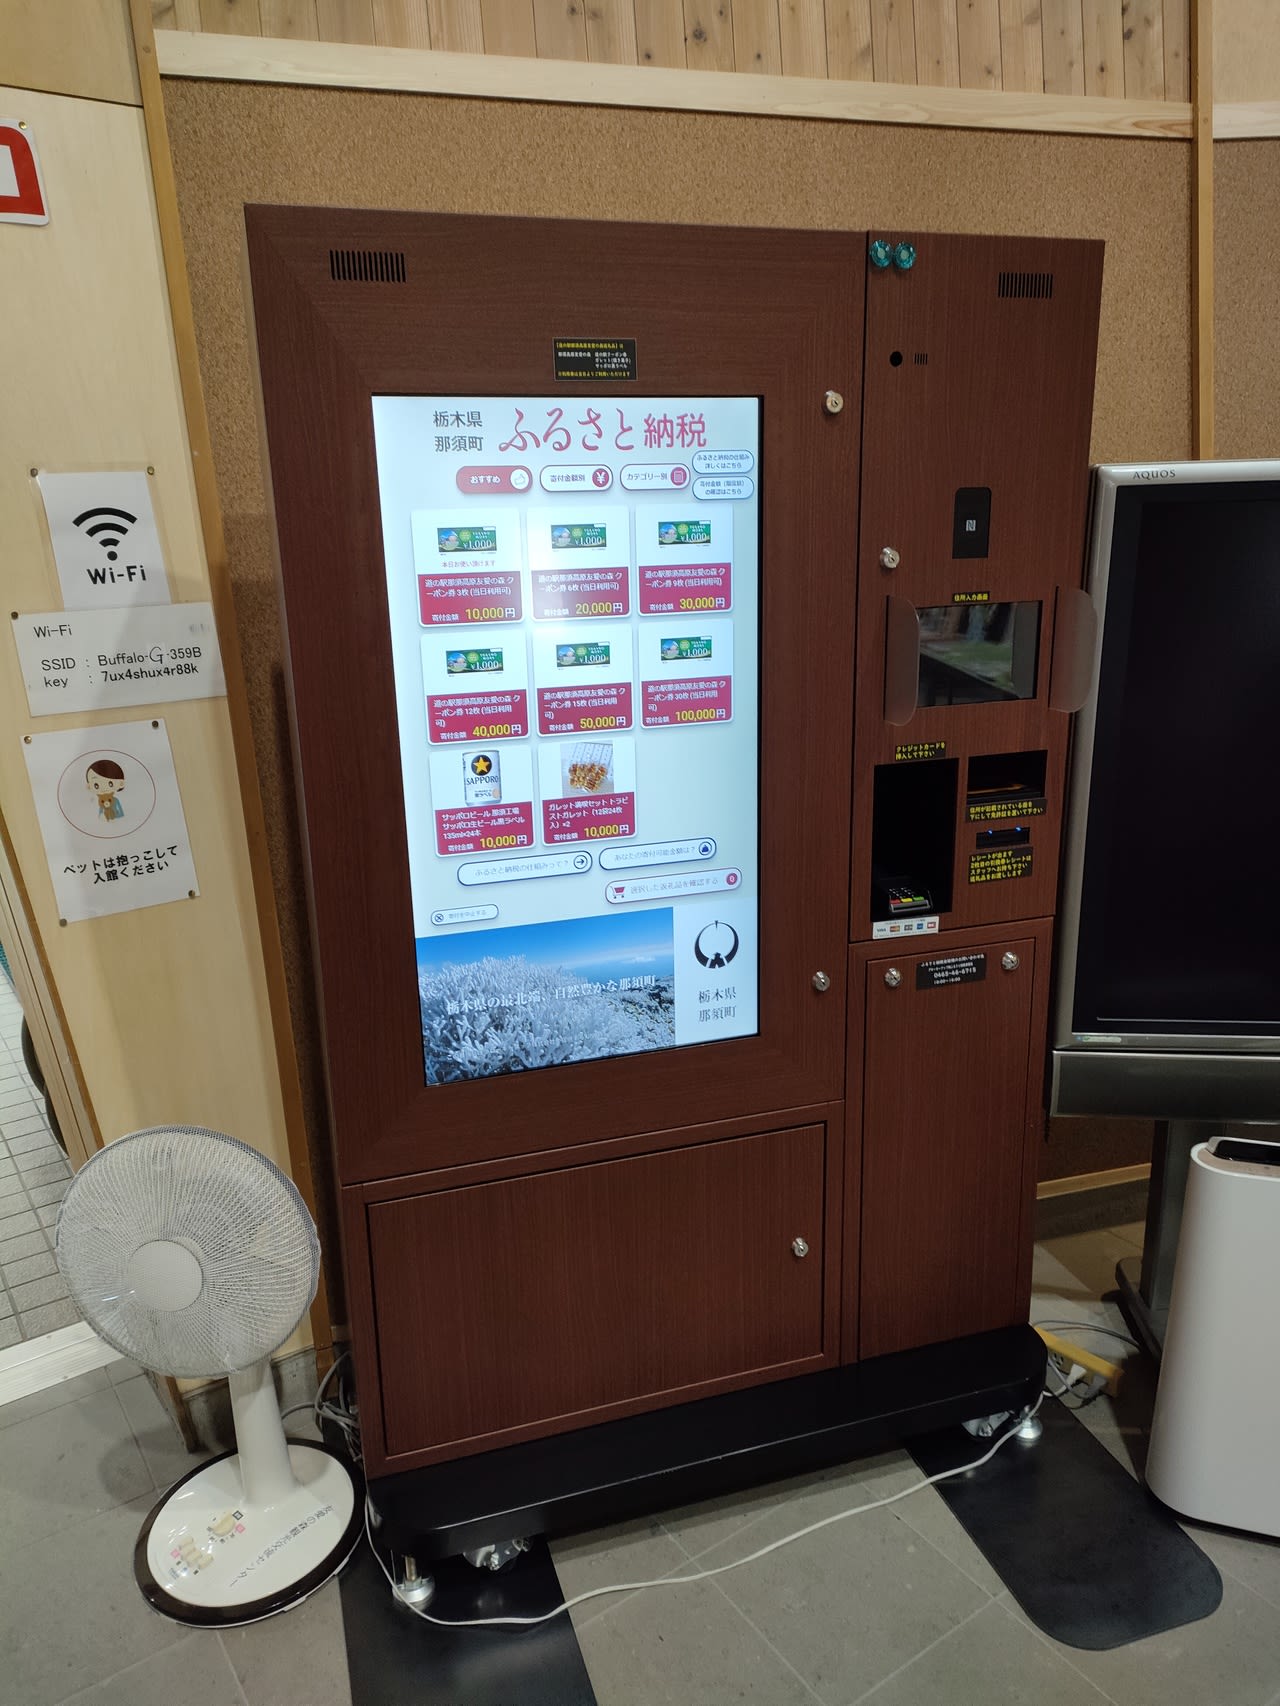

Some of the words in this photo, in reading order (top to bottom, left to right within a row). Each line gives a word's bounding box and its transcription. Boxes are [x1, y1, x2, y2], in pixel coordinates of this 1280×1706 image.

[433, 411, 482, 428] 栃木県
[498, 408, 707, 452] ふるさと納税
[434, 436, 483, 452] 那須町
[469, 475, 500, 484] おすすめ
[626, 472, 667, 480] カテゴリー別
[1133, 469, 1176, 479] AQUOS
[86, 565, 146, 585] Wi-Fi
[576, 602, 623, 616] 20,000円
[680, 597, 725, 610] 30,000円
[466, 607, 516, 620] 10,000円
[33, 624, 72, 638] Wi-Fi
[41, 657, 76, 671] SSID
[44, 676, 68, 688] key
[101, 664, 199, 682] 7ux4shux4r88k
[675, 708, 725, 721] 100,000円
[579, 716, 626, 729] 50,000円
[472, 724, 522, 737] 40,000円
[466, 776, 499, 785] SAPPORO
[584, 825, 629, 837] 10,000円
[480, 835, 527, 848] 10,000円
[94, 861, 169, 884] 入館ください
[699, 986, 736, 1004] 栃木県
[699, 1005, 736, 1022] 那須町
